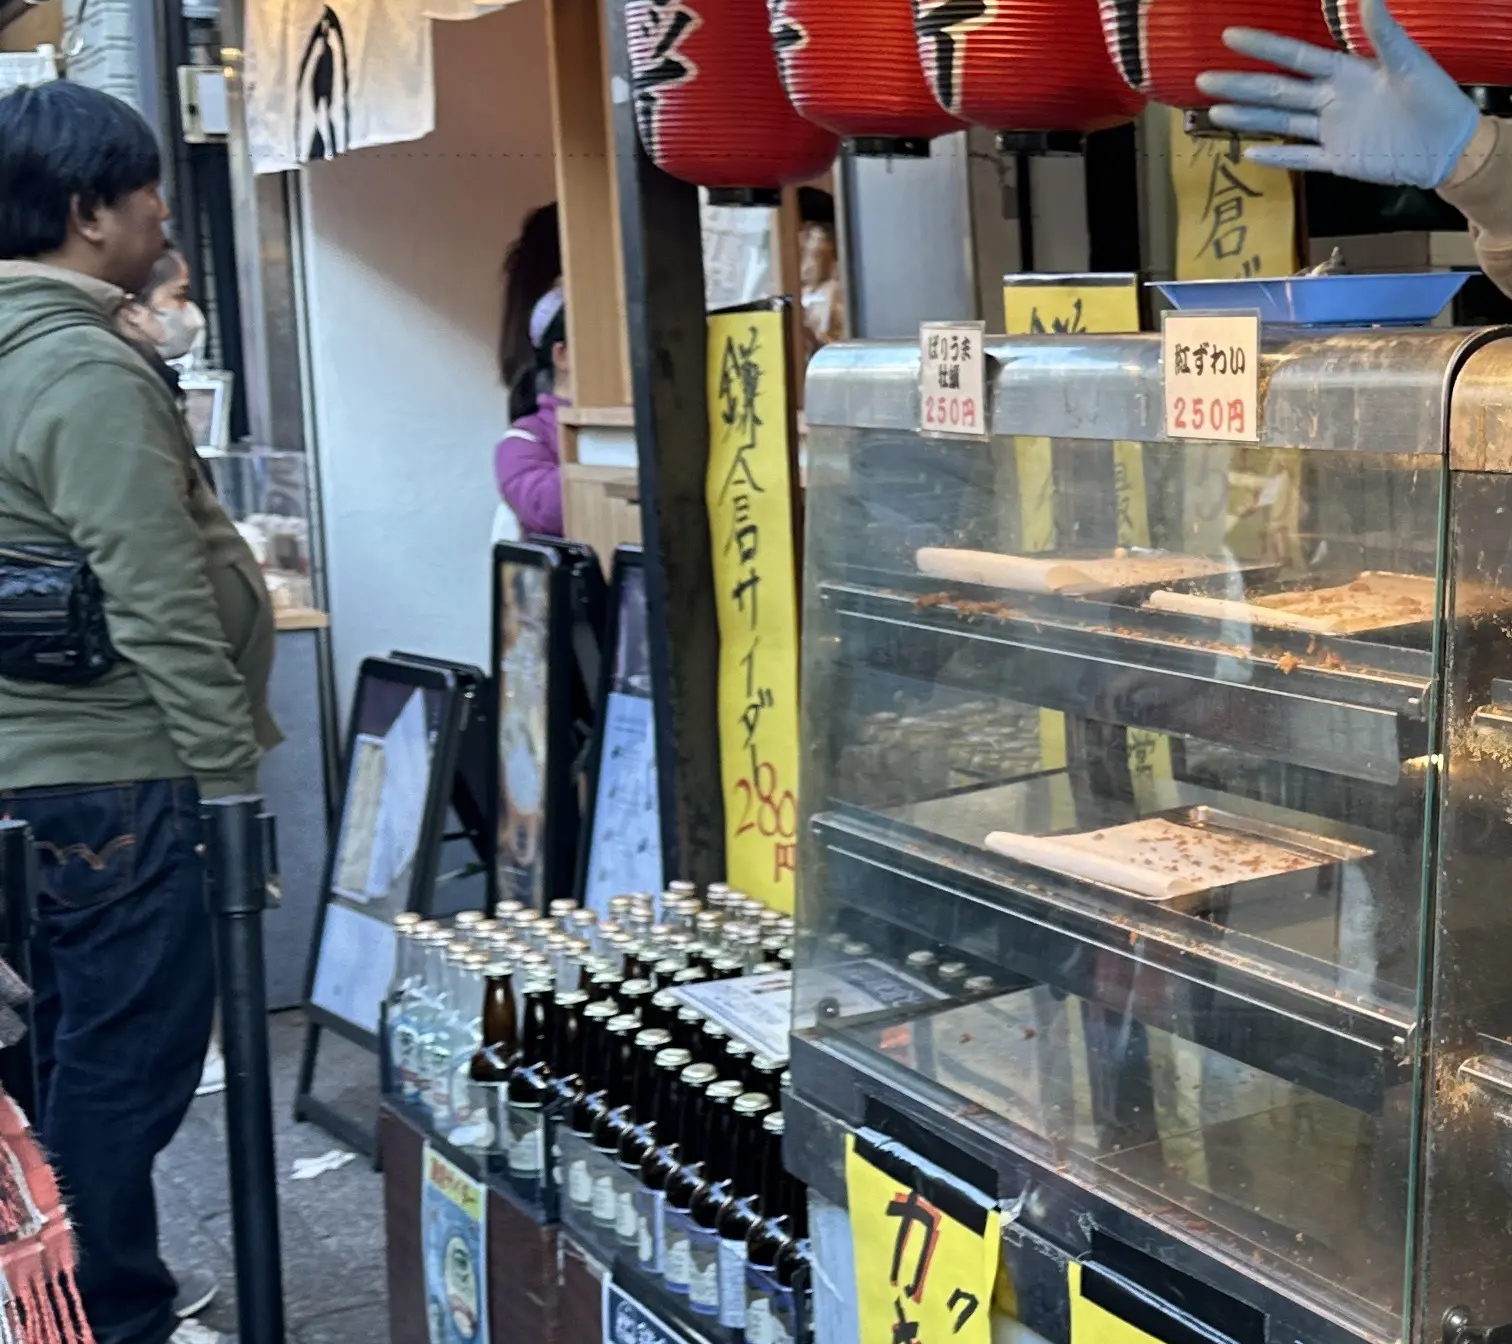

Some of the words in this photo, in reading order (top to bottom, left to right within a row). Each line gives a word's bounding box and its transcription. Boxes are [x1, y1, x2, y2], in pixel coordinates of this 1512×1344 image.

[1174, 342, 1246, 376] 紅ずわい
[926, 396, 976, 427] 250円
[1173, 396, 1246, 434] 250円
